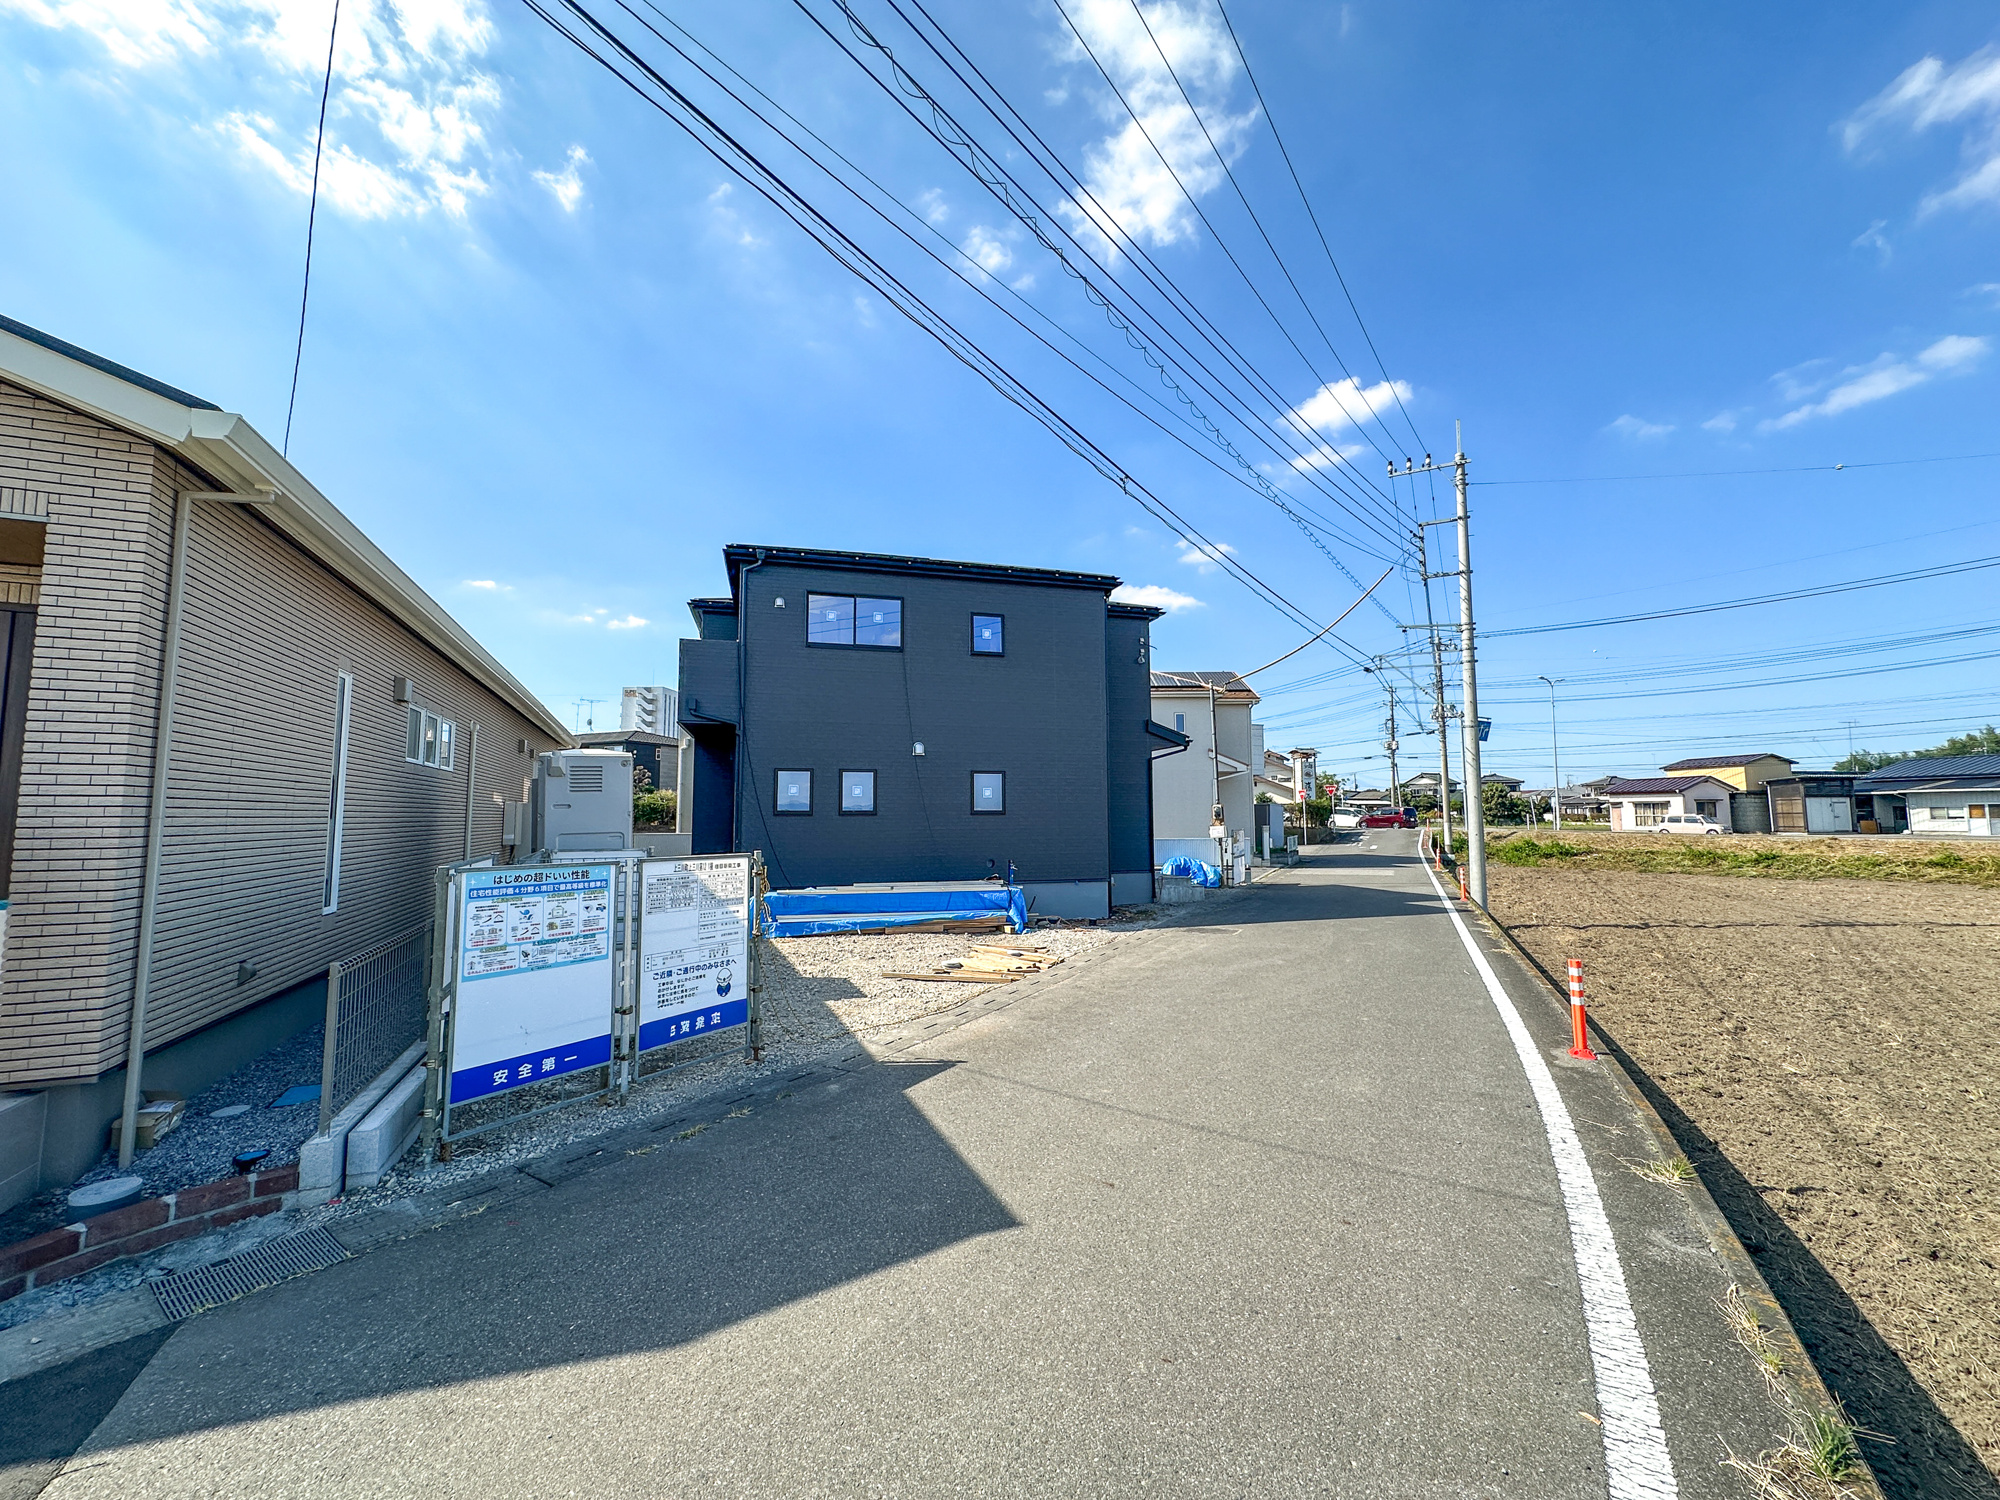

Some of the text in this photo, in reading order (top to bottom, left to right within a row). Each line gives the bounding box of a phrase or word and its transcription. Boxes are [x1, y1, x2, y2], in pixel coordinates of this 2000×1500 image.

[493, 869, 591, 885] はじめの超ドいい性能
[652, 958, 737, 981] ご近隣・ご通行中のみなさまへ
[492, 1055, 578, 1086] 安全第一
